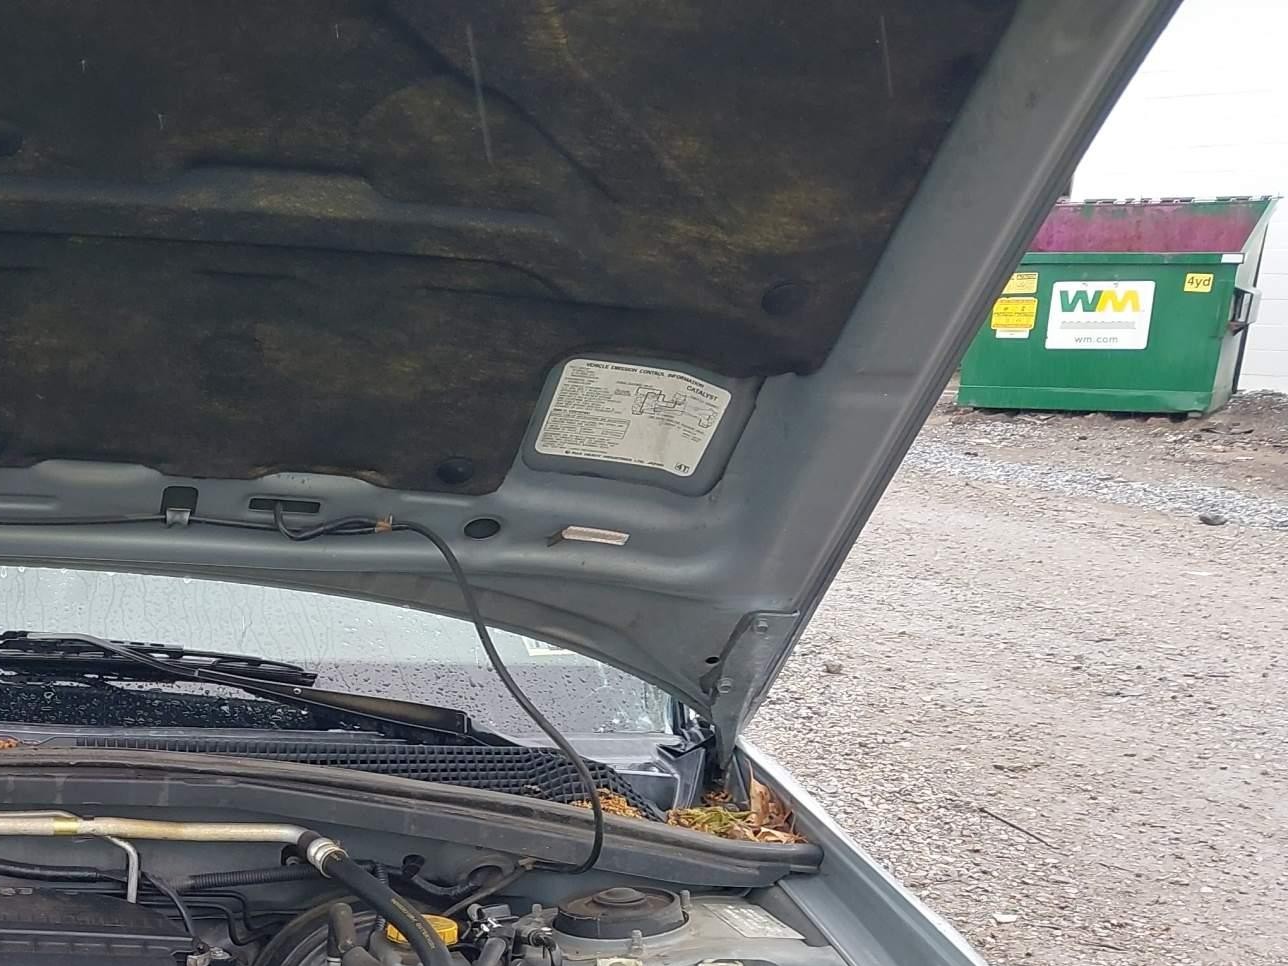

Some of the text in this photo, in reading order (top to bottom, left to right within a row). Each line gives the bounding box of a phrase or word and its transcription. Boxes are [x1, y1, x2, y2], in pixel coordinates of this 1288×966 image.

[1186, 276, 1212, 288] 4yd
[1059, 289, 1141, 313] WM
[1074, 335, 1119, 344] wm.com
[586, 362, 705, 389] VEHICLE EMISSION CONTROL INFORMATION
[686, 385, 719, 402] CATALYST
